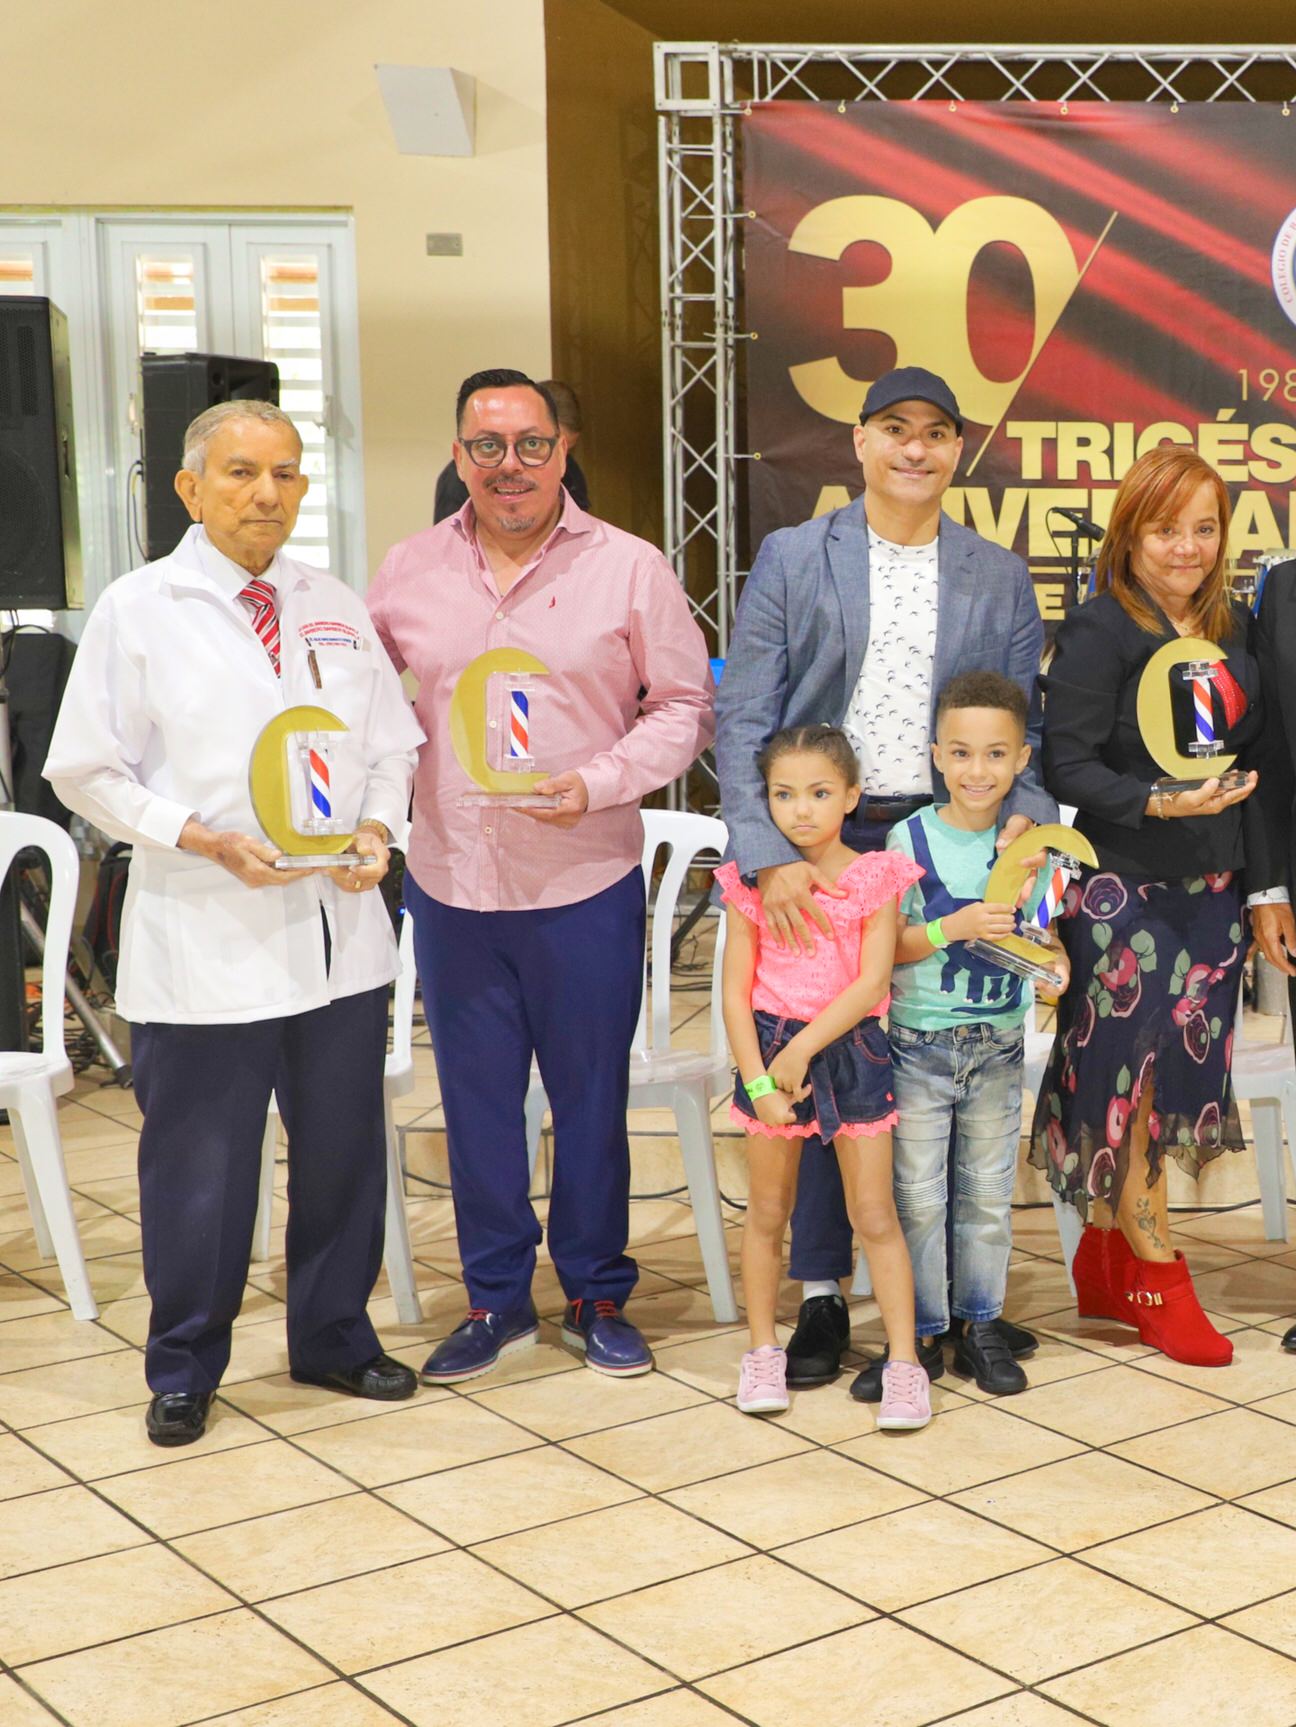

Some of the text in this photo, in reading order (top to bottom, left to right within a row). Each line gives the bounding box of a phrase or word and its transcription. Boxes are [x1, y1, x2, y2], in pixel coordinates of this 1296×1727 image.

[1281, 233, 1292, 247] DE
[1277, 249, 1293, 304] COLEGIO
[788, 195, 1080, 427] 30
